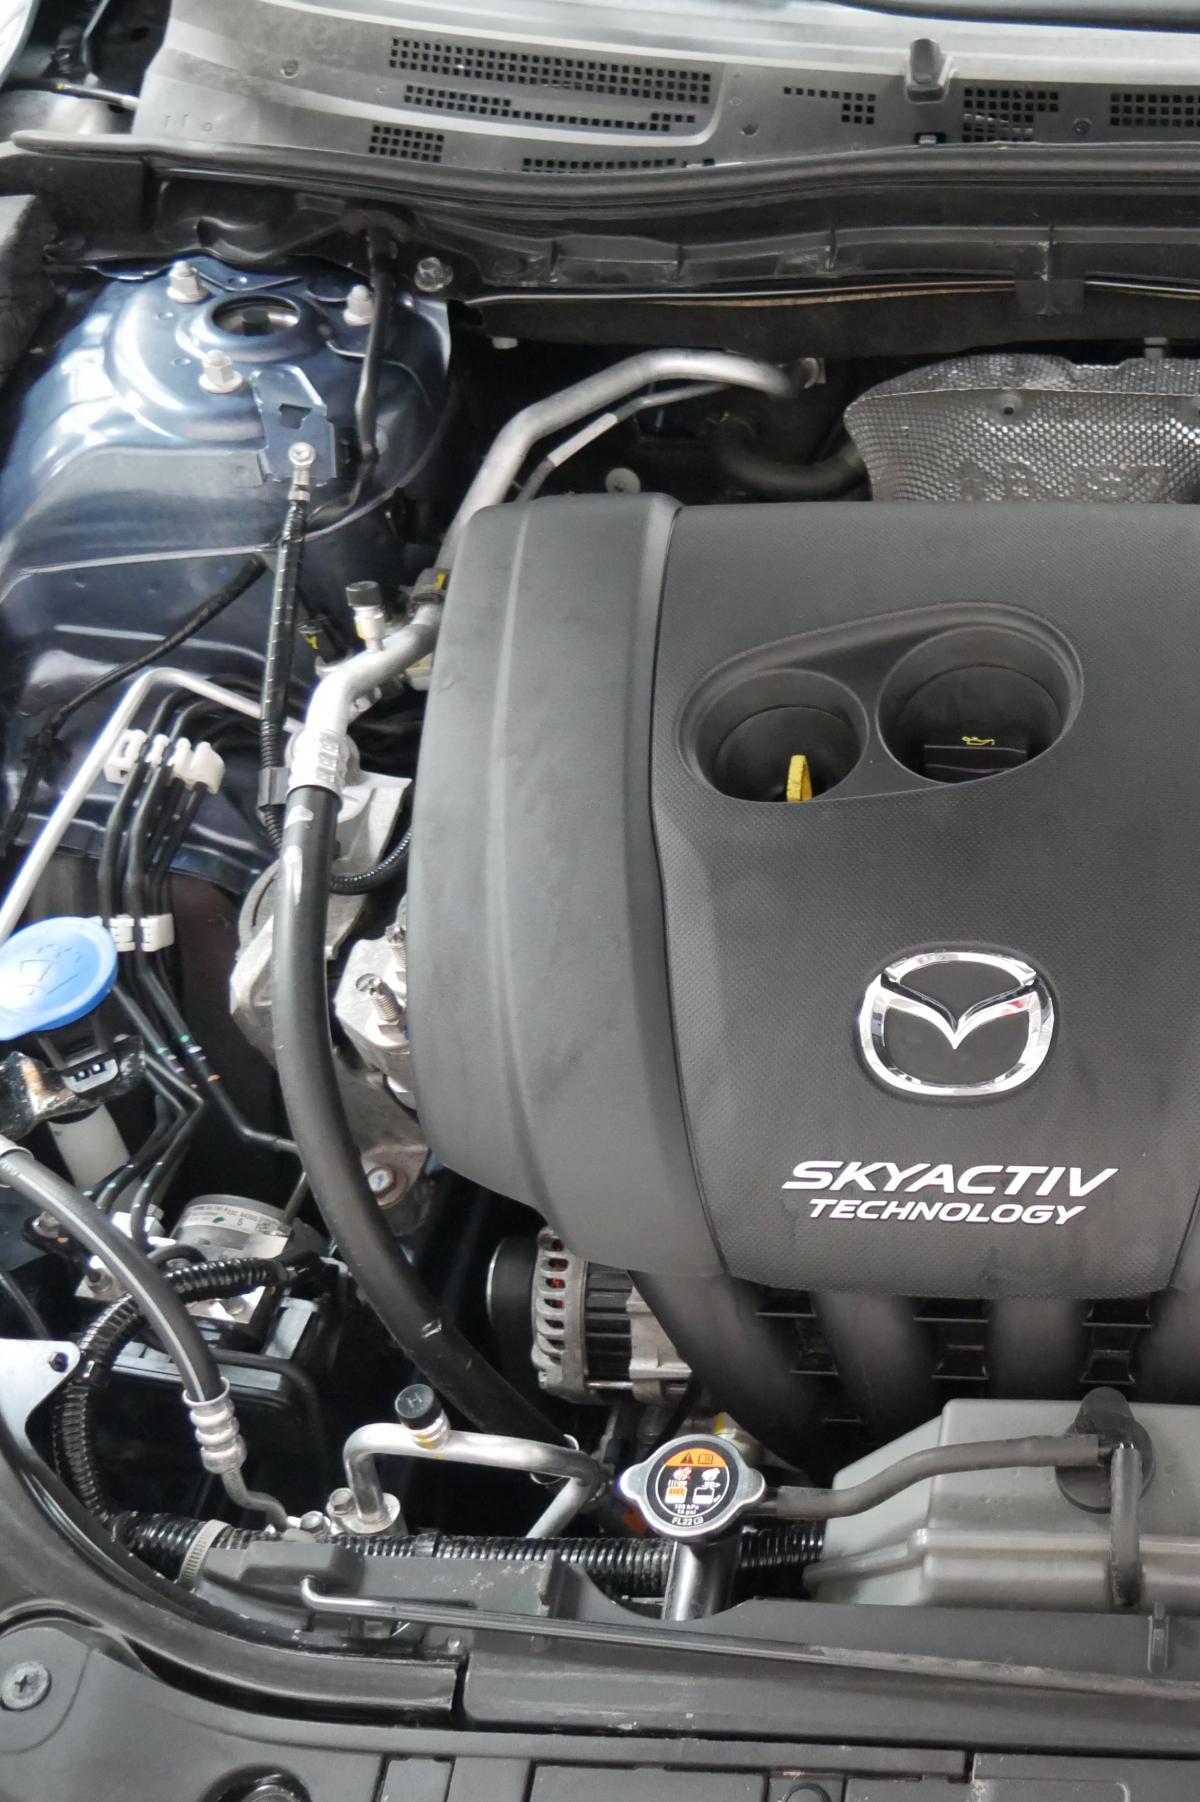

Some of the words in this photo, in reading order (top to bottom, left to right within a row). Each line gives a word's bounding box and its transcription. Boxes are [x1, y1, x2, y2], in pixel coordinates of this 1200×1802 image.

[781, 1160, 1120, 1197] SKYACTIV
[808, 1198, 1087, 1225] TECHNOLOGY
[406, 1392, 423, 1408] H
[672, 1517, 693, 1525] FL22
